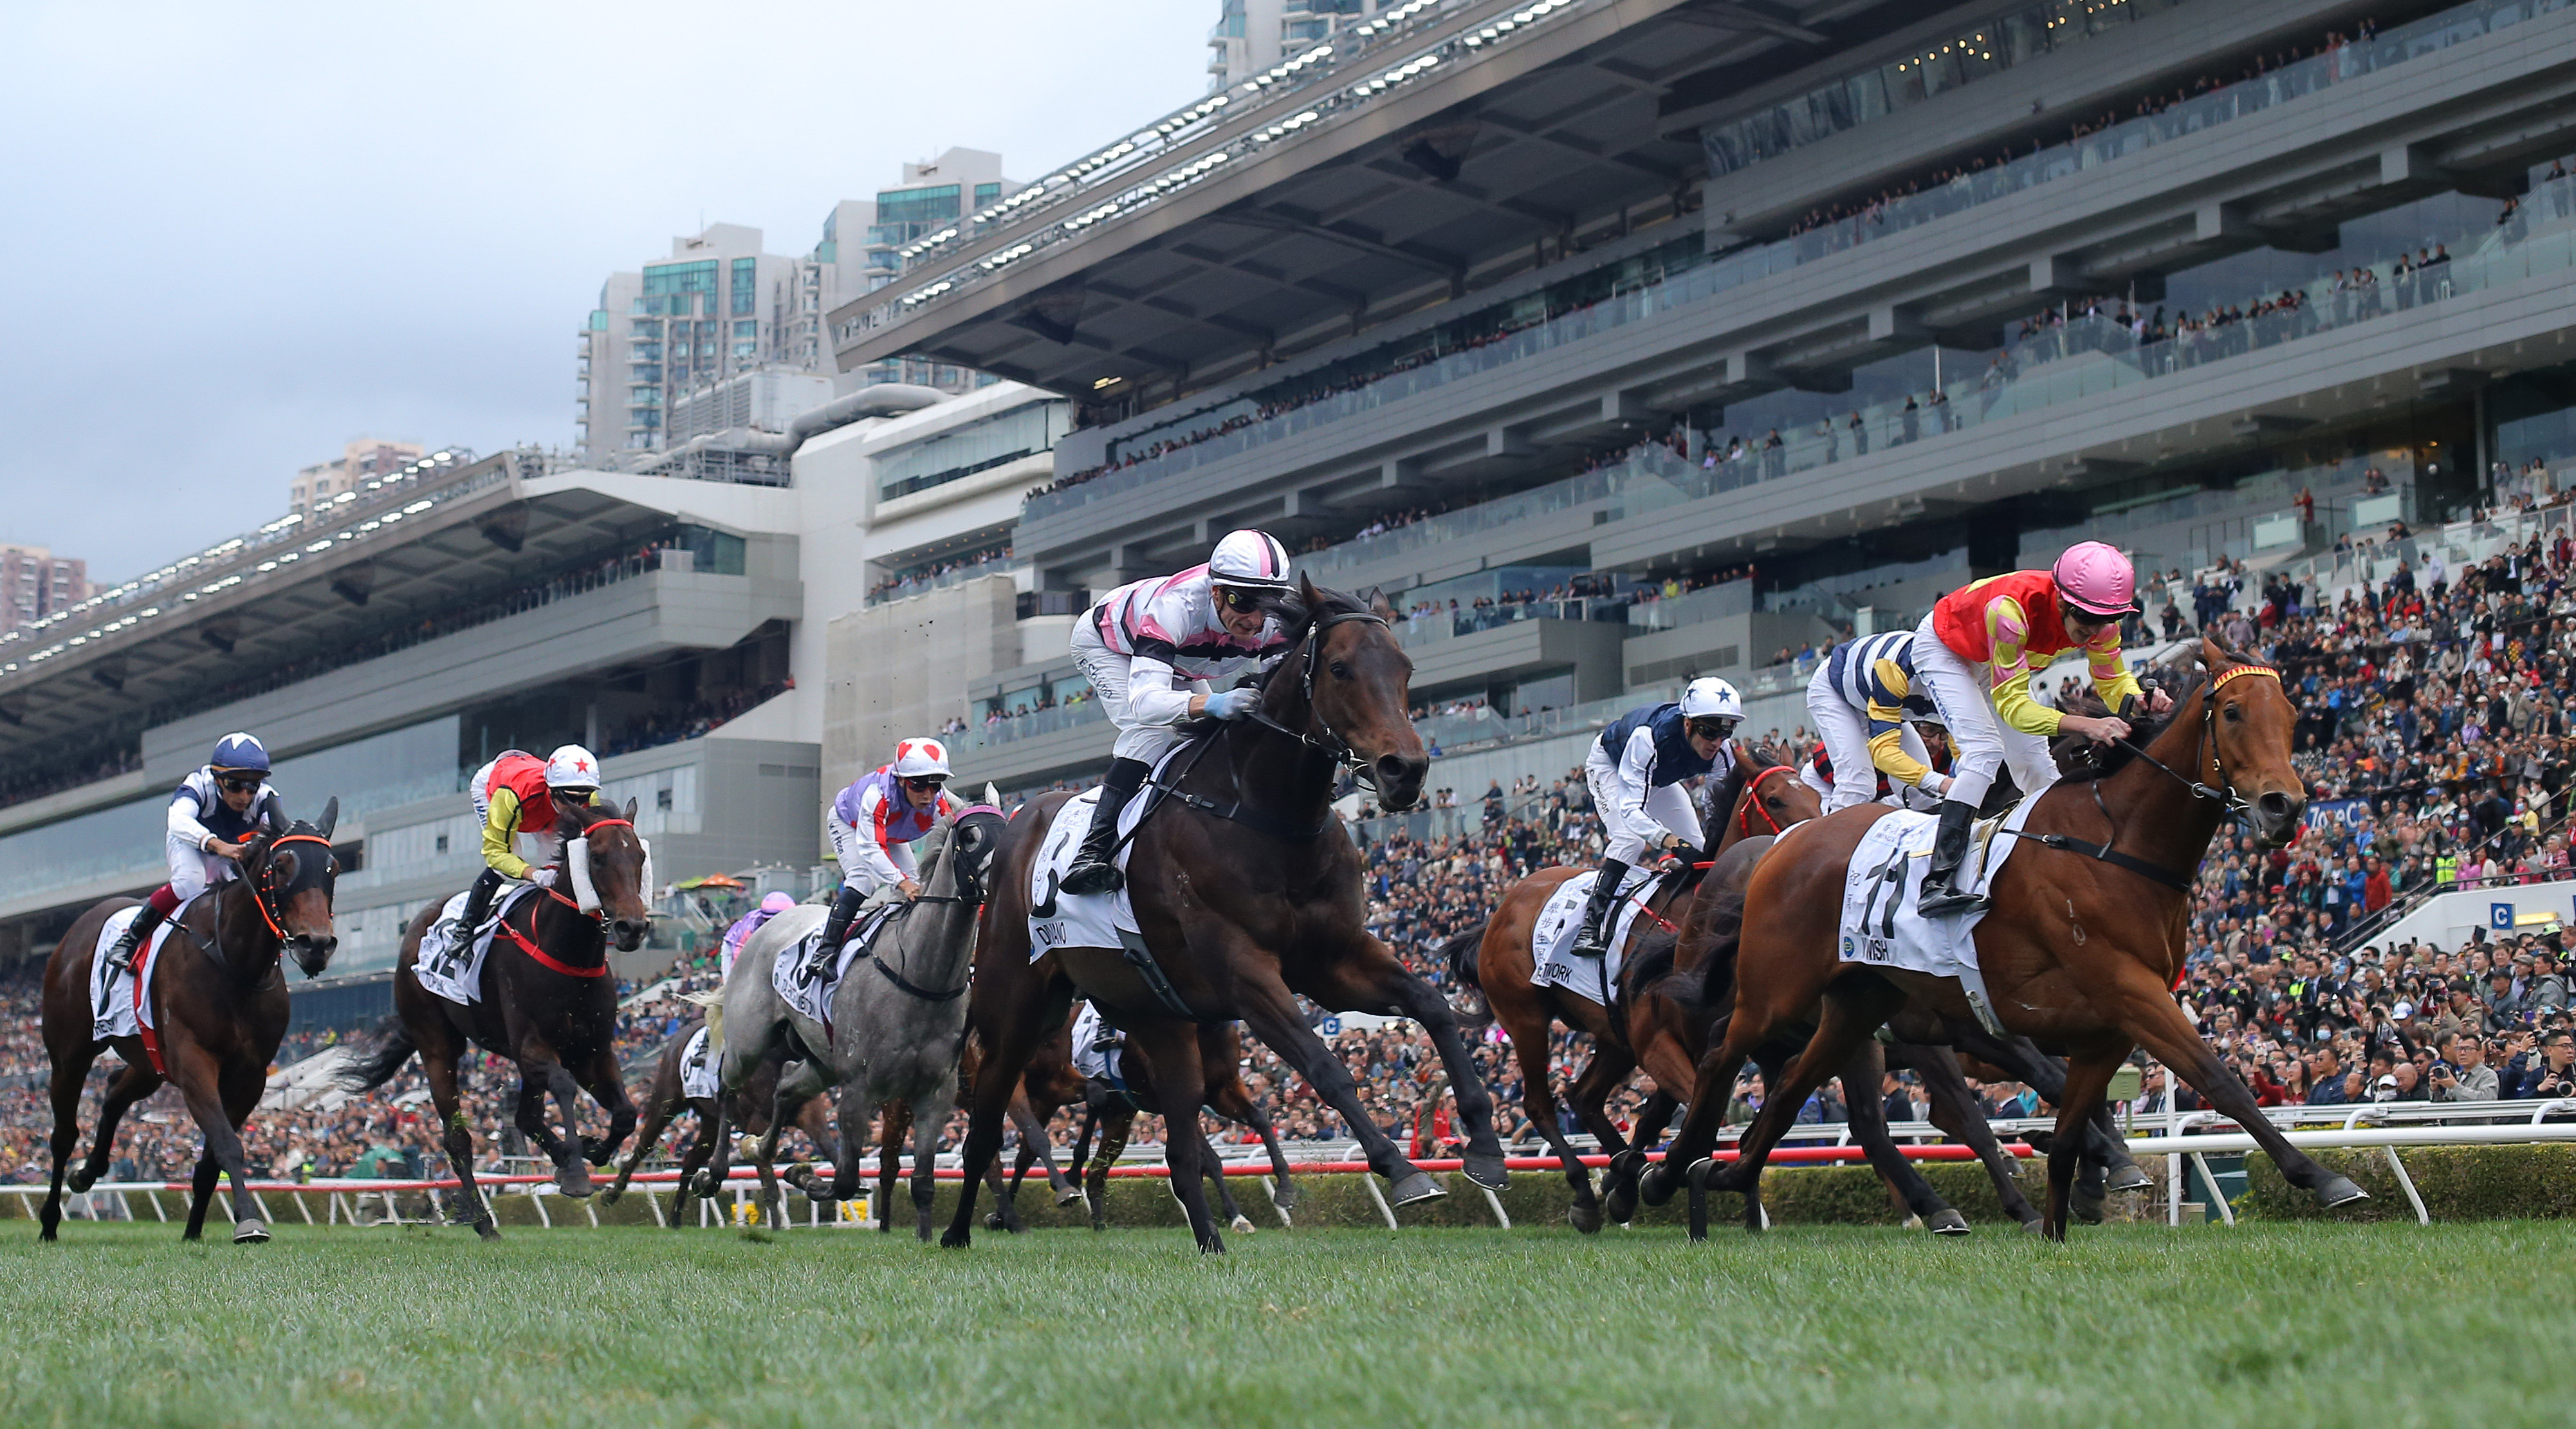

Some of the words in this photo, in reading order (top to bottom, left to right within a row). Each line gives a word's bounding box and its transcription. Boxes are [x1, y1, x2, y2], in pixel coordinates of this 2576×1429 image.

[1862, 847, 1909, 939] 11
[2495, 907, 2508, 925] C
[1325, 1019, 1336, 1033] C
